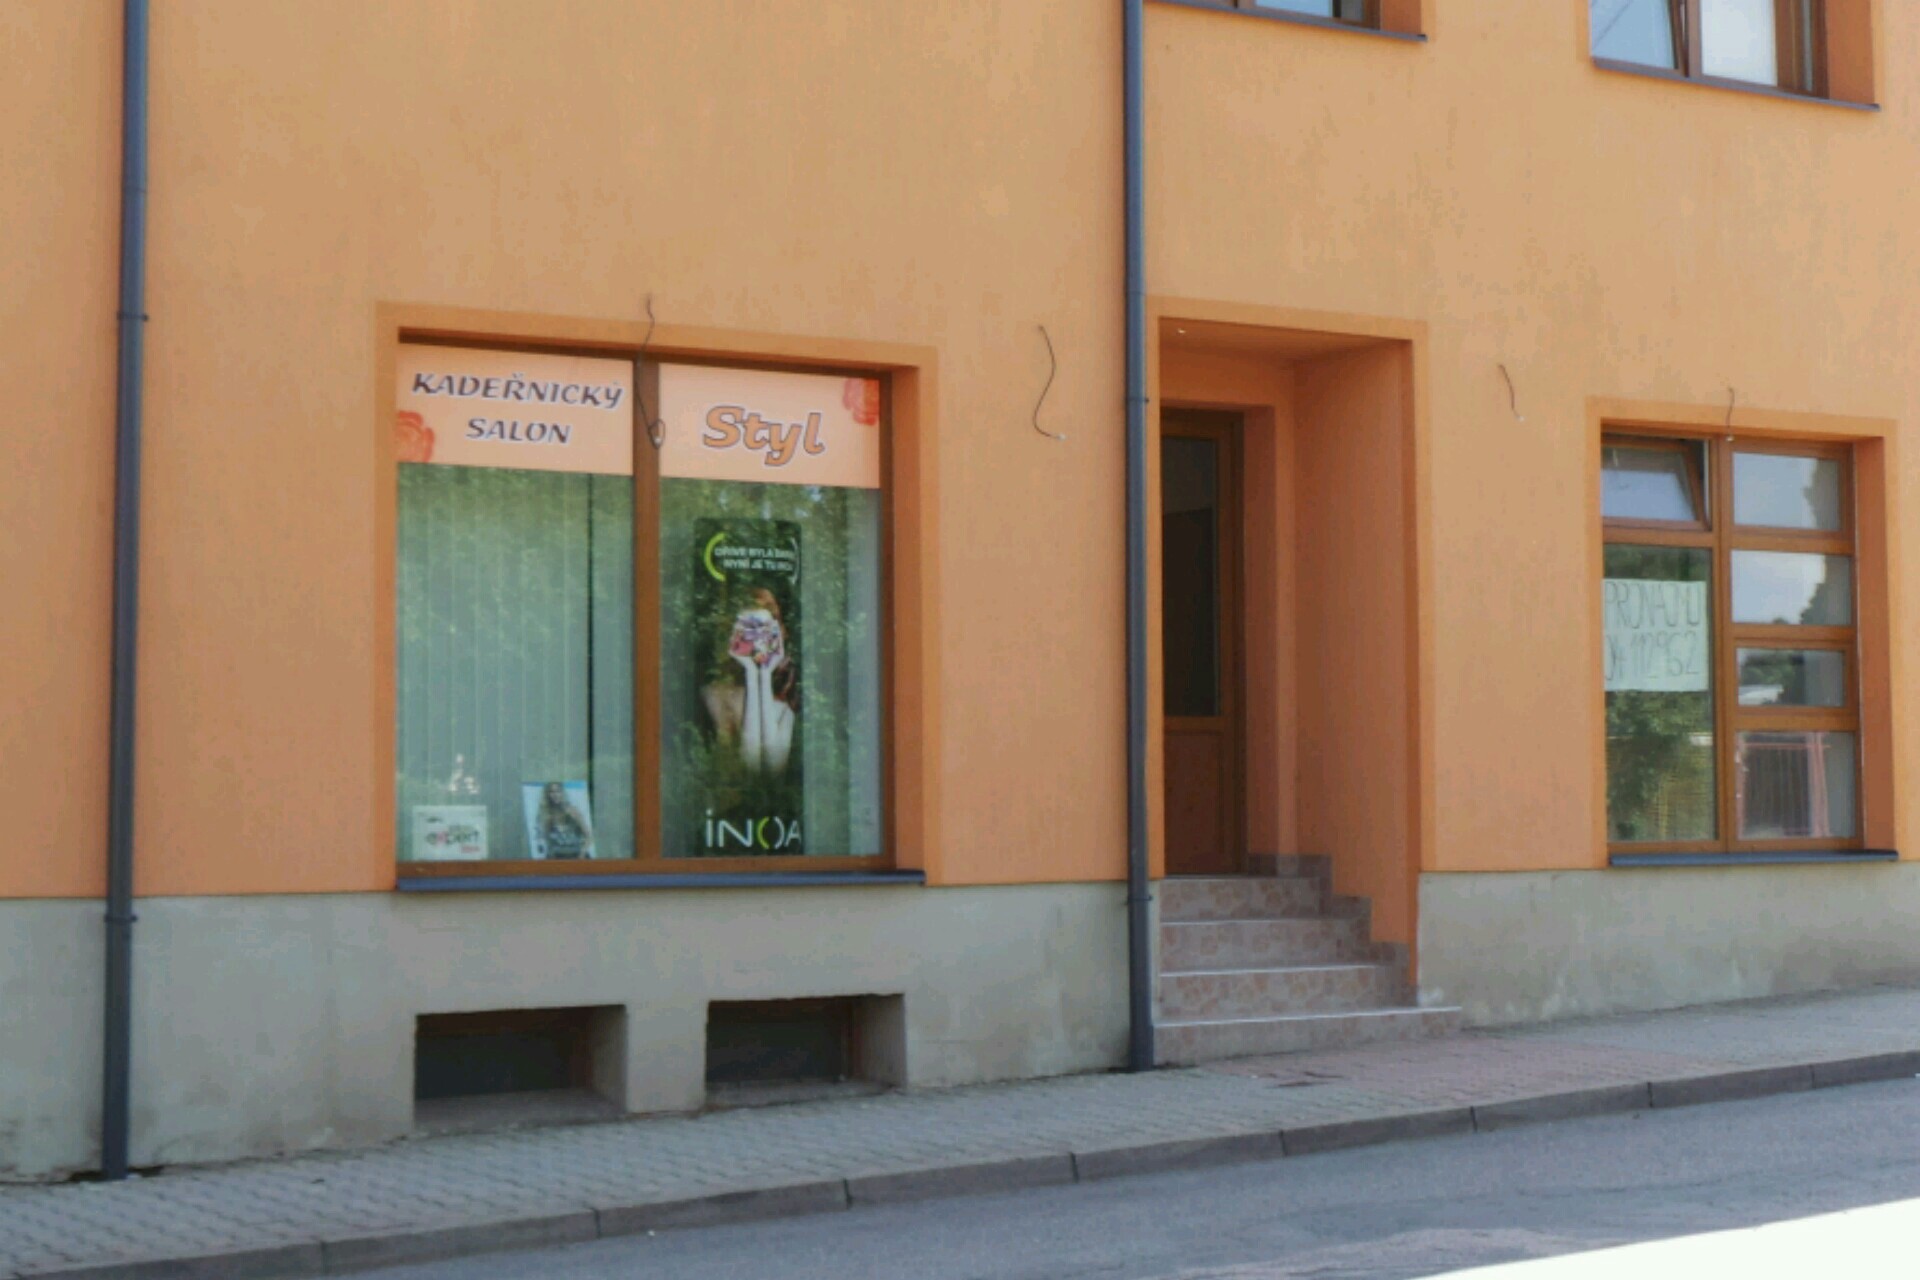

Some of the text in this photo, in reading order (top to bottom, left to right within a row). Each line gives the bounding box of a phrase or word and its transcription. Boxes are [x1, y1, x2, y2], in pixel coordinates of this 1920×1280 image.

[412, 371, 623, 409] KADEŘNICKÝ
[466, 417, 570, 444] SALON
[703, 405, 825, 466] Styl
